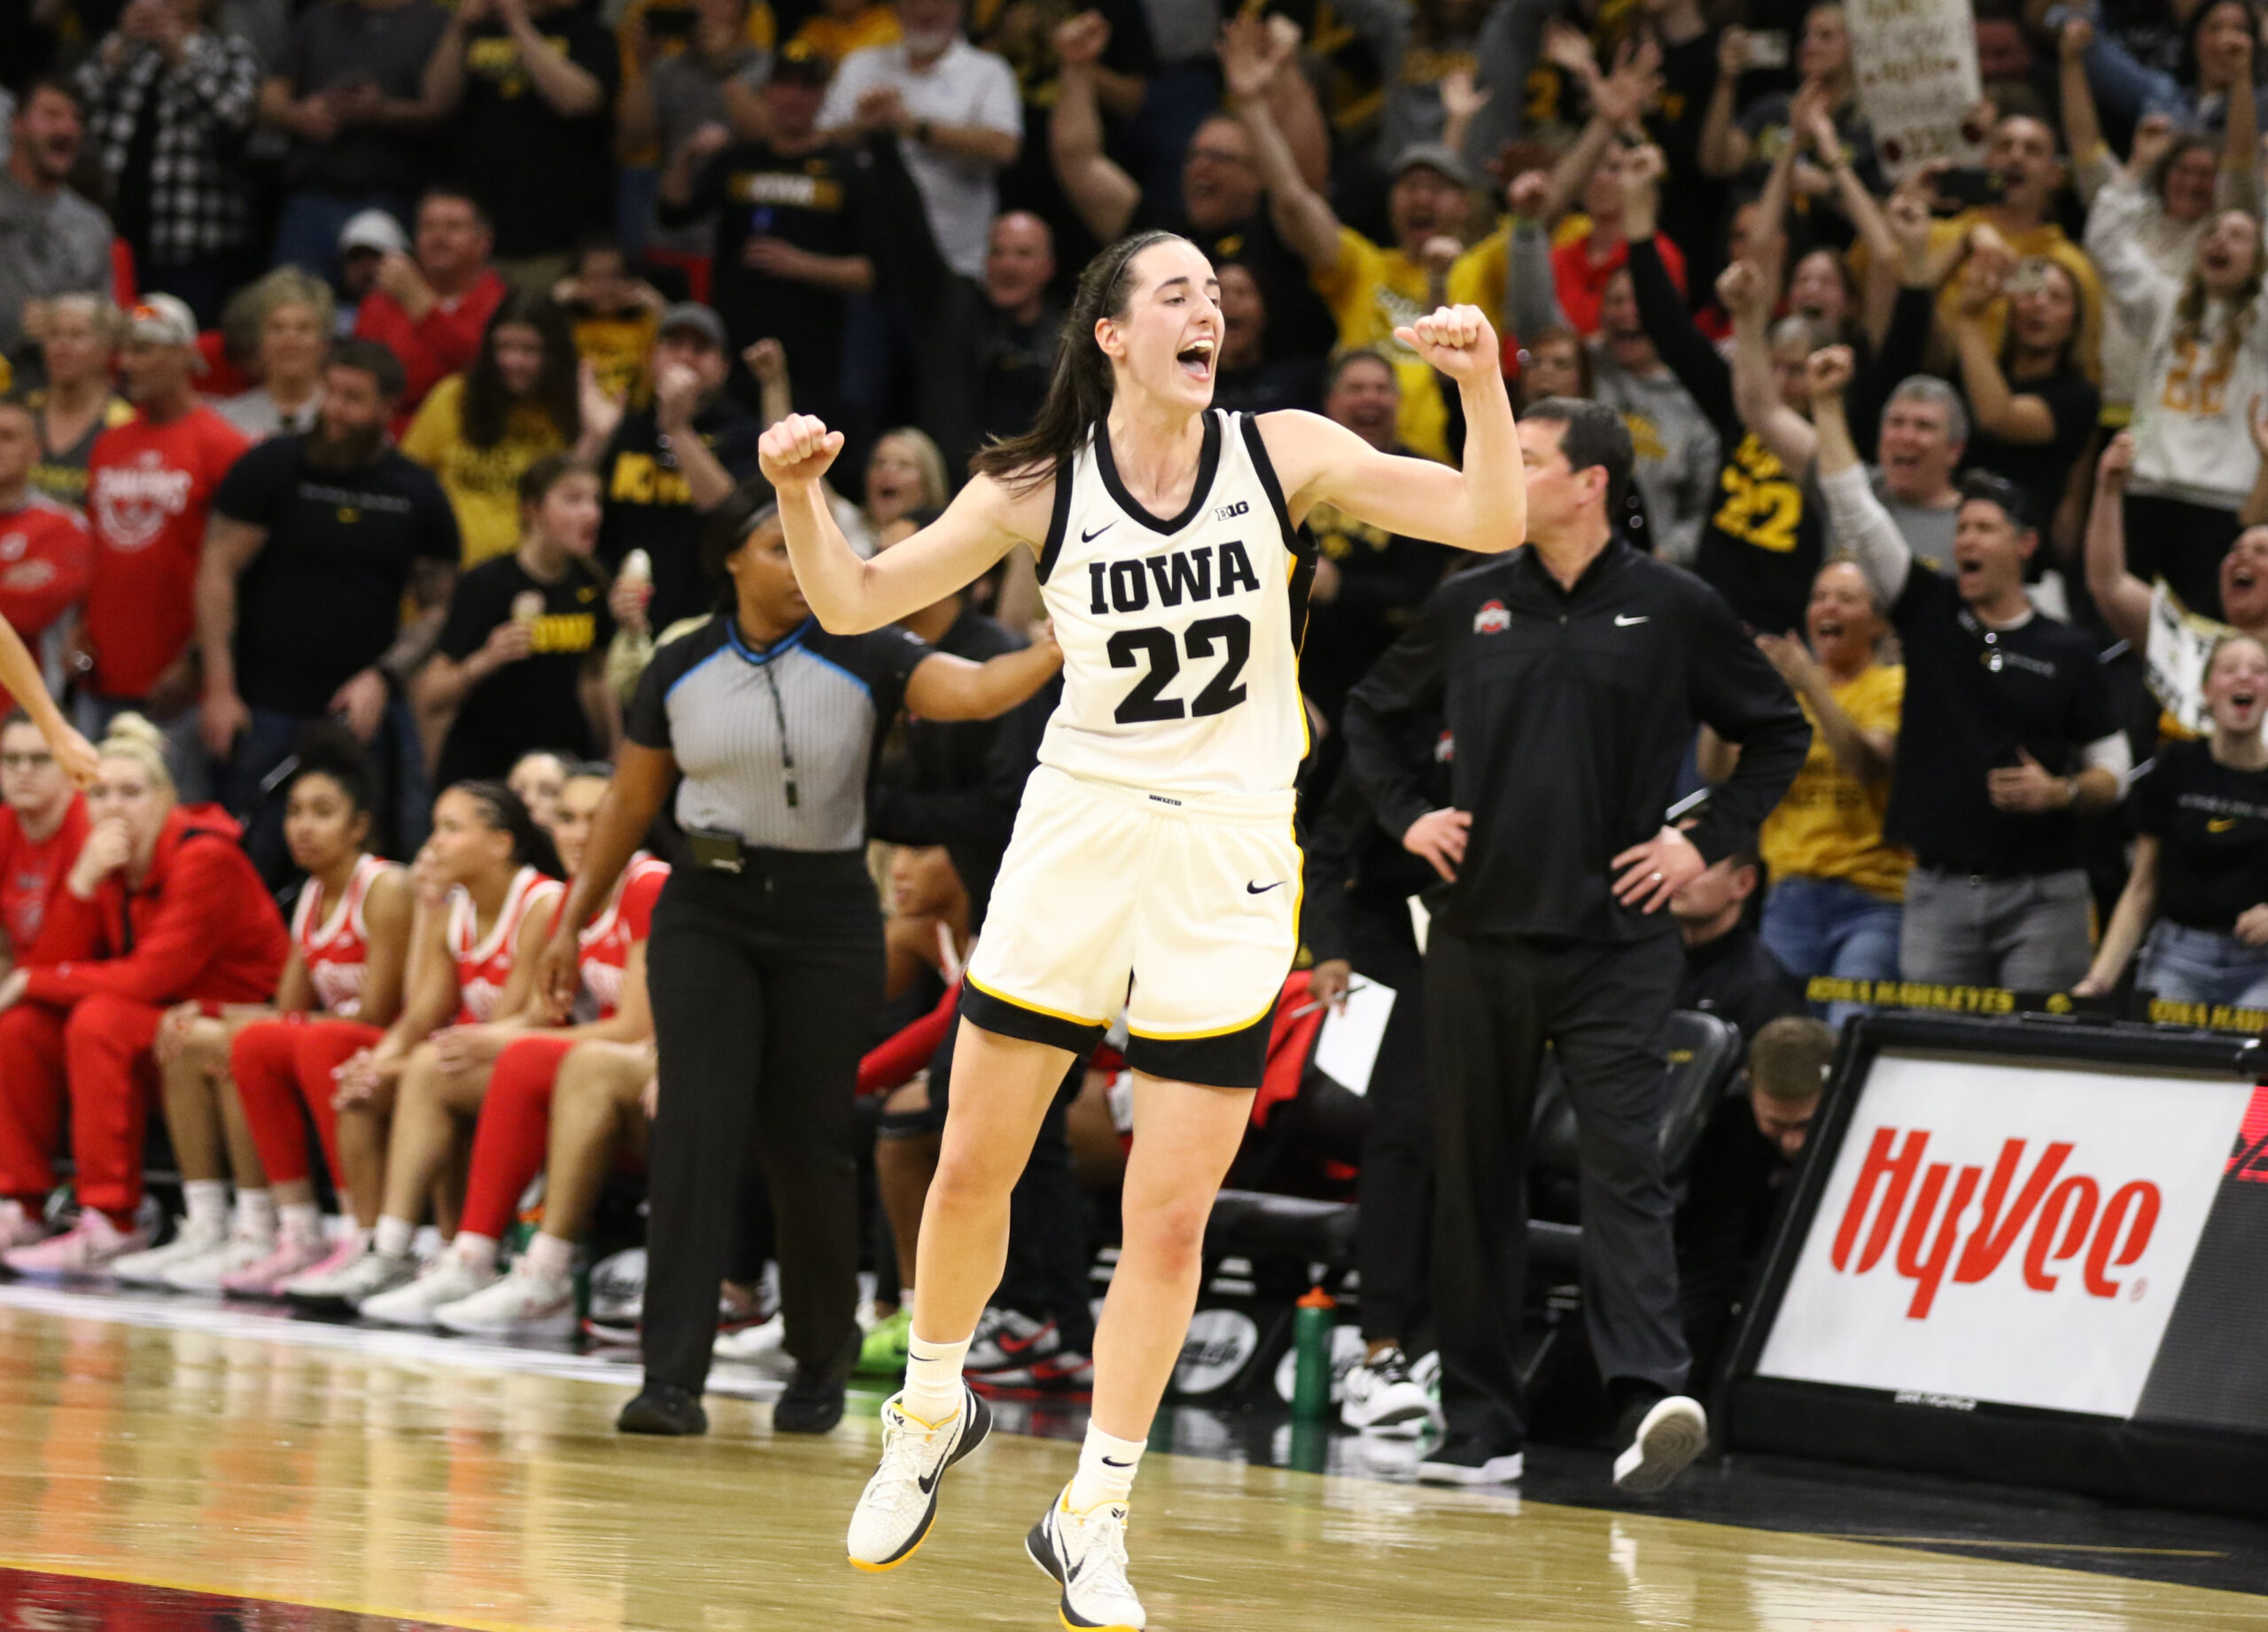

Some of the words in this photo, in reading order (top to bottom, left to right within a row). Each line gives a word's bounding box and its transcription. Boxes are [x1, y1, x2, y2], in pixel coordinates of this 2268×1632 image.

[1713, 465, 1803, 553] 22
[1089, 540, 1260, 615] IOWA
[1107, 614, 1251, 724] 22
